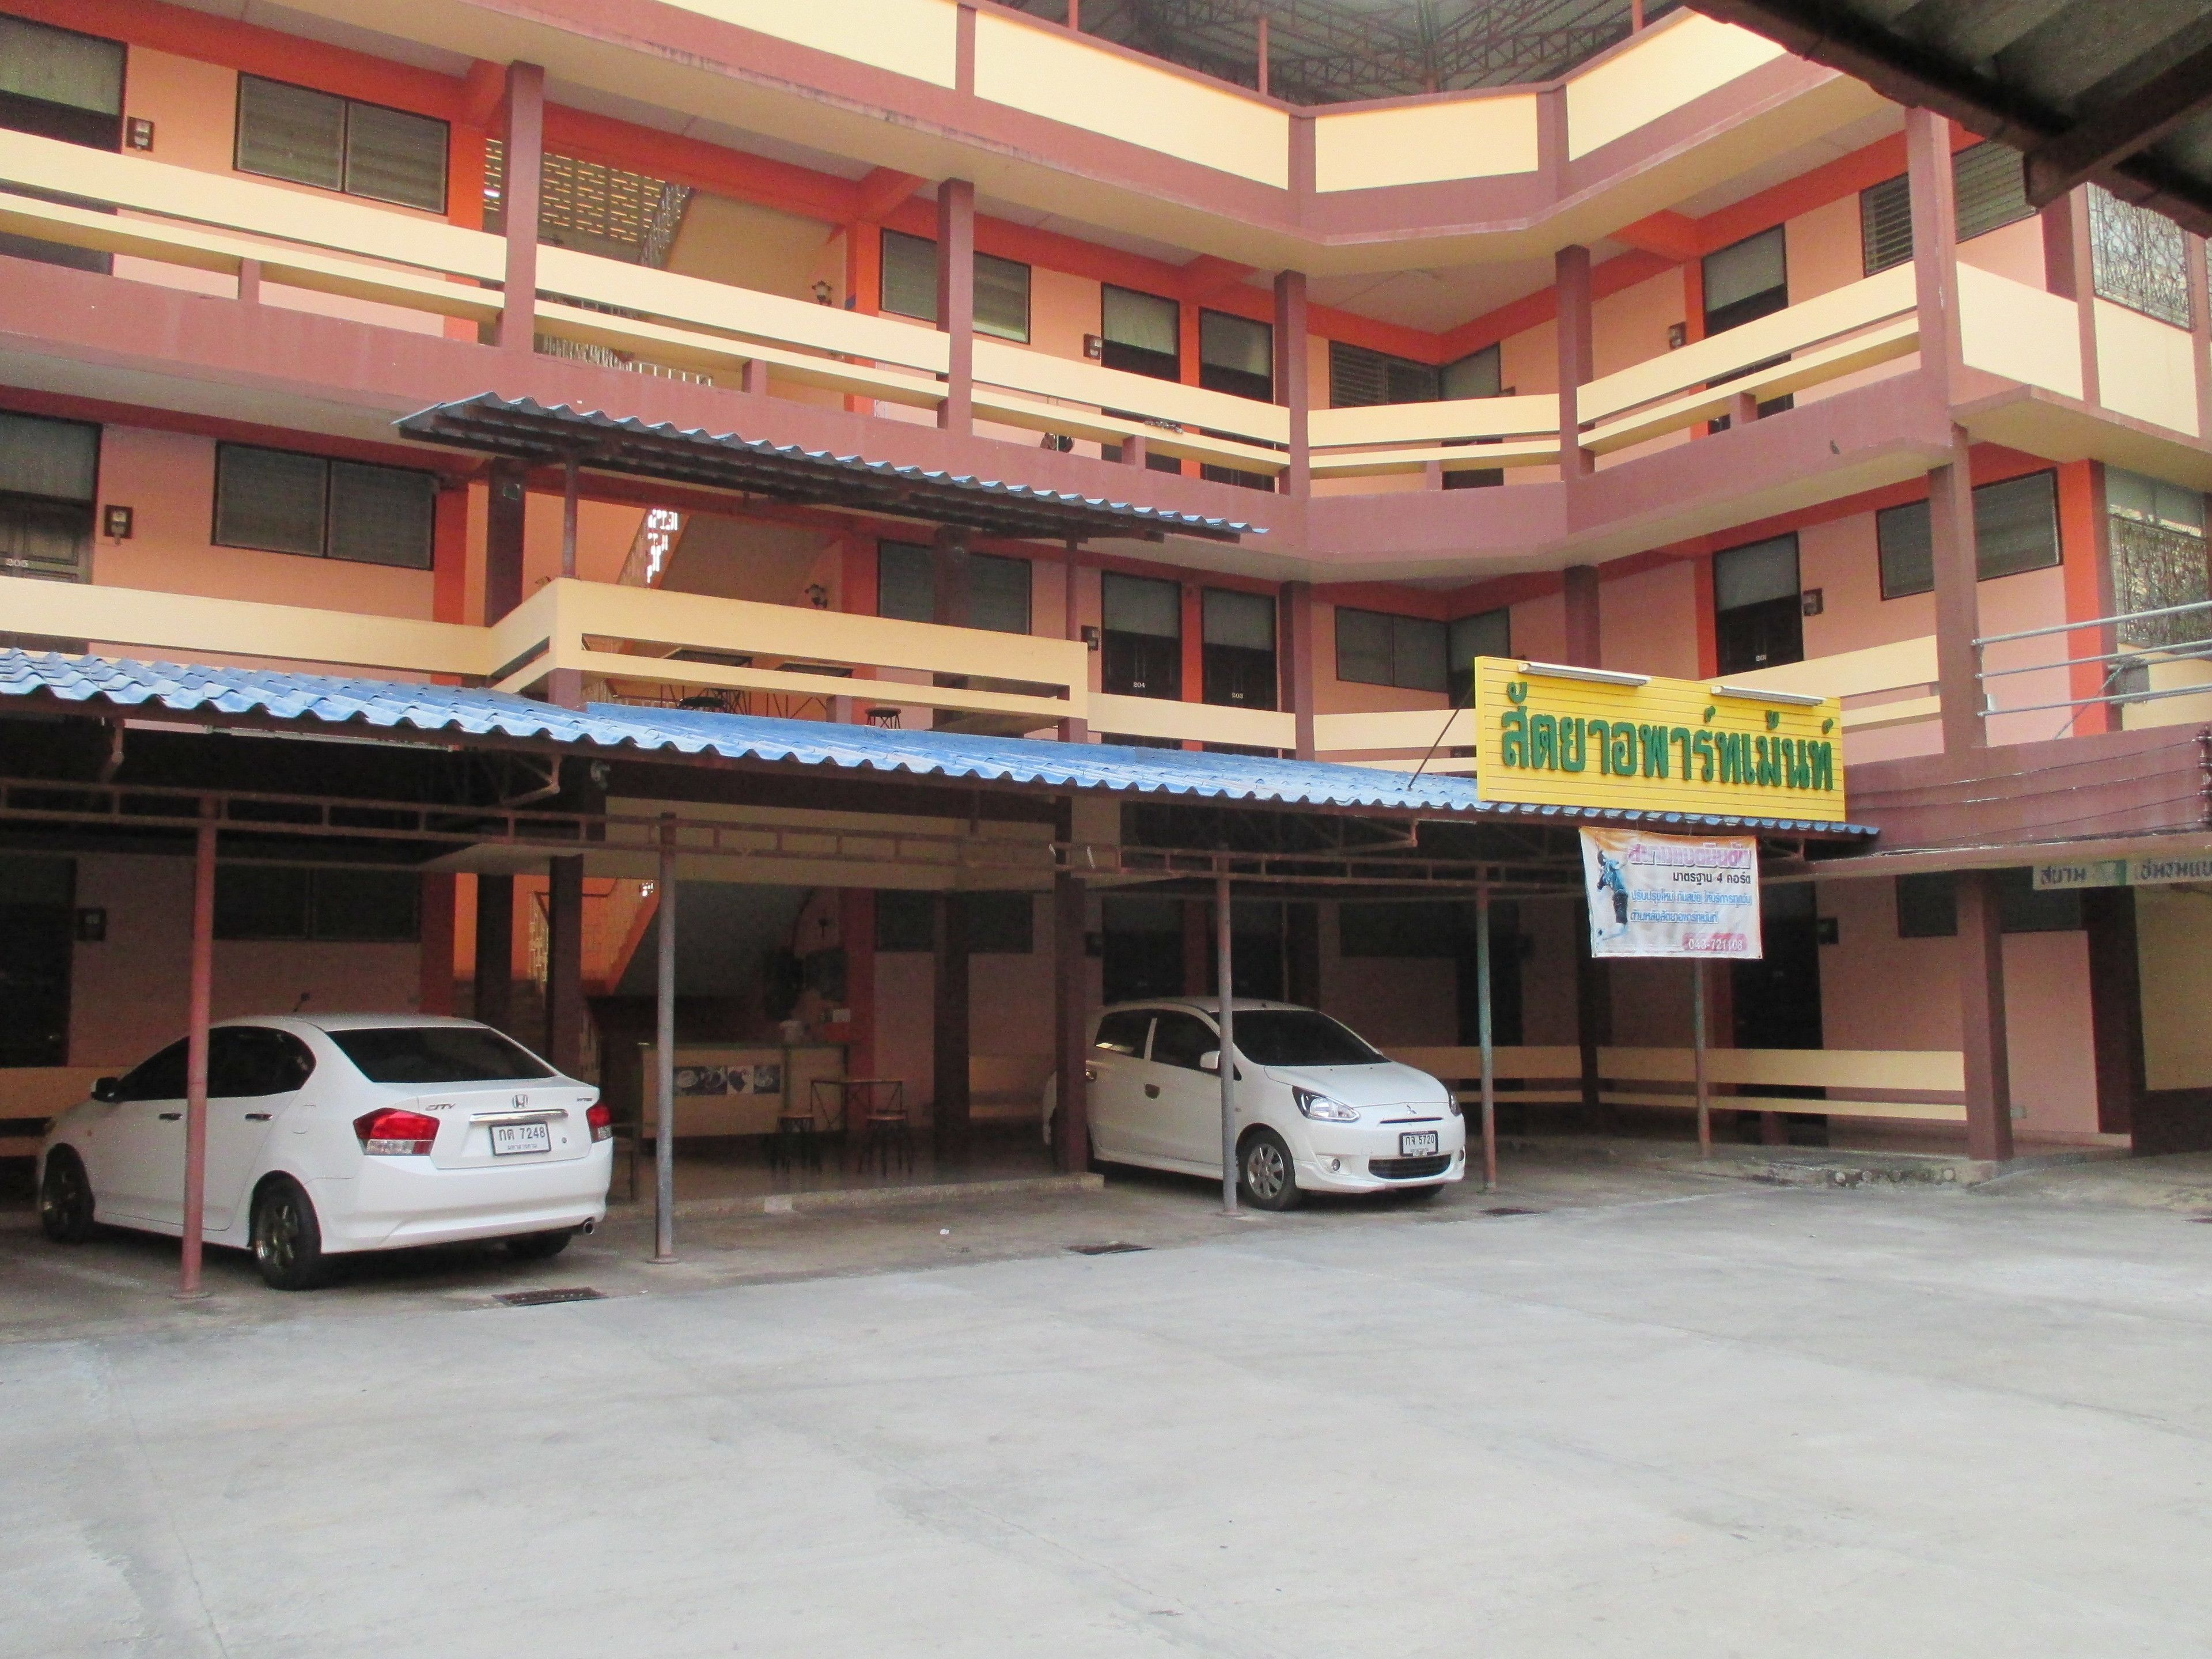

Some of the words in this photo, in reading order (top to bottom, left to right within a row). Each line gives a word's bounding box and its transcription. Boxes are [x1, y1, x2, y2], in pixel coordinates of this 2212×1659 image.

[1673, 872, 1712, 885] มาตรฐาน
[1717, 873, 1722, 883] 4
[520, 1127, 545, 1139] 7248
[1418, 1135, 1435, 1144] 5720
